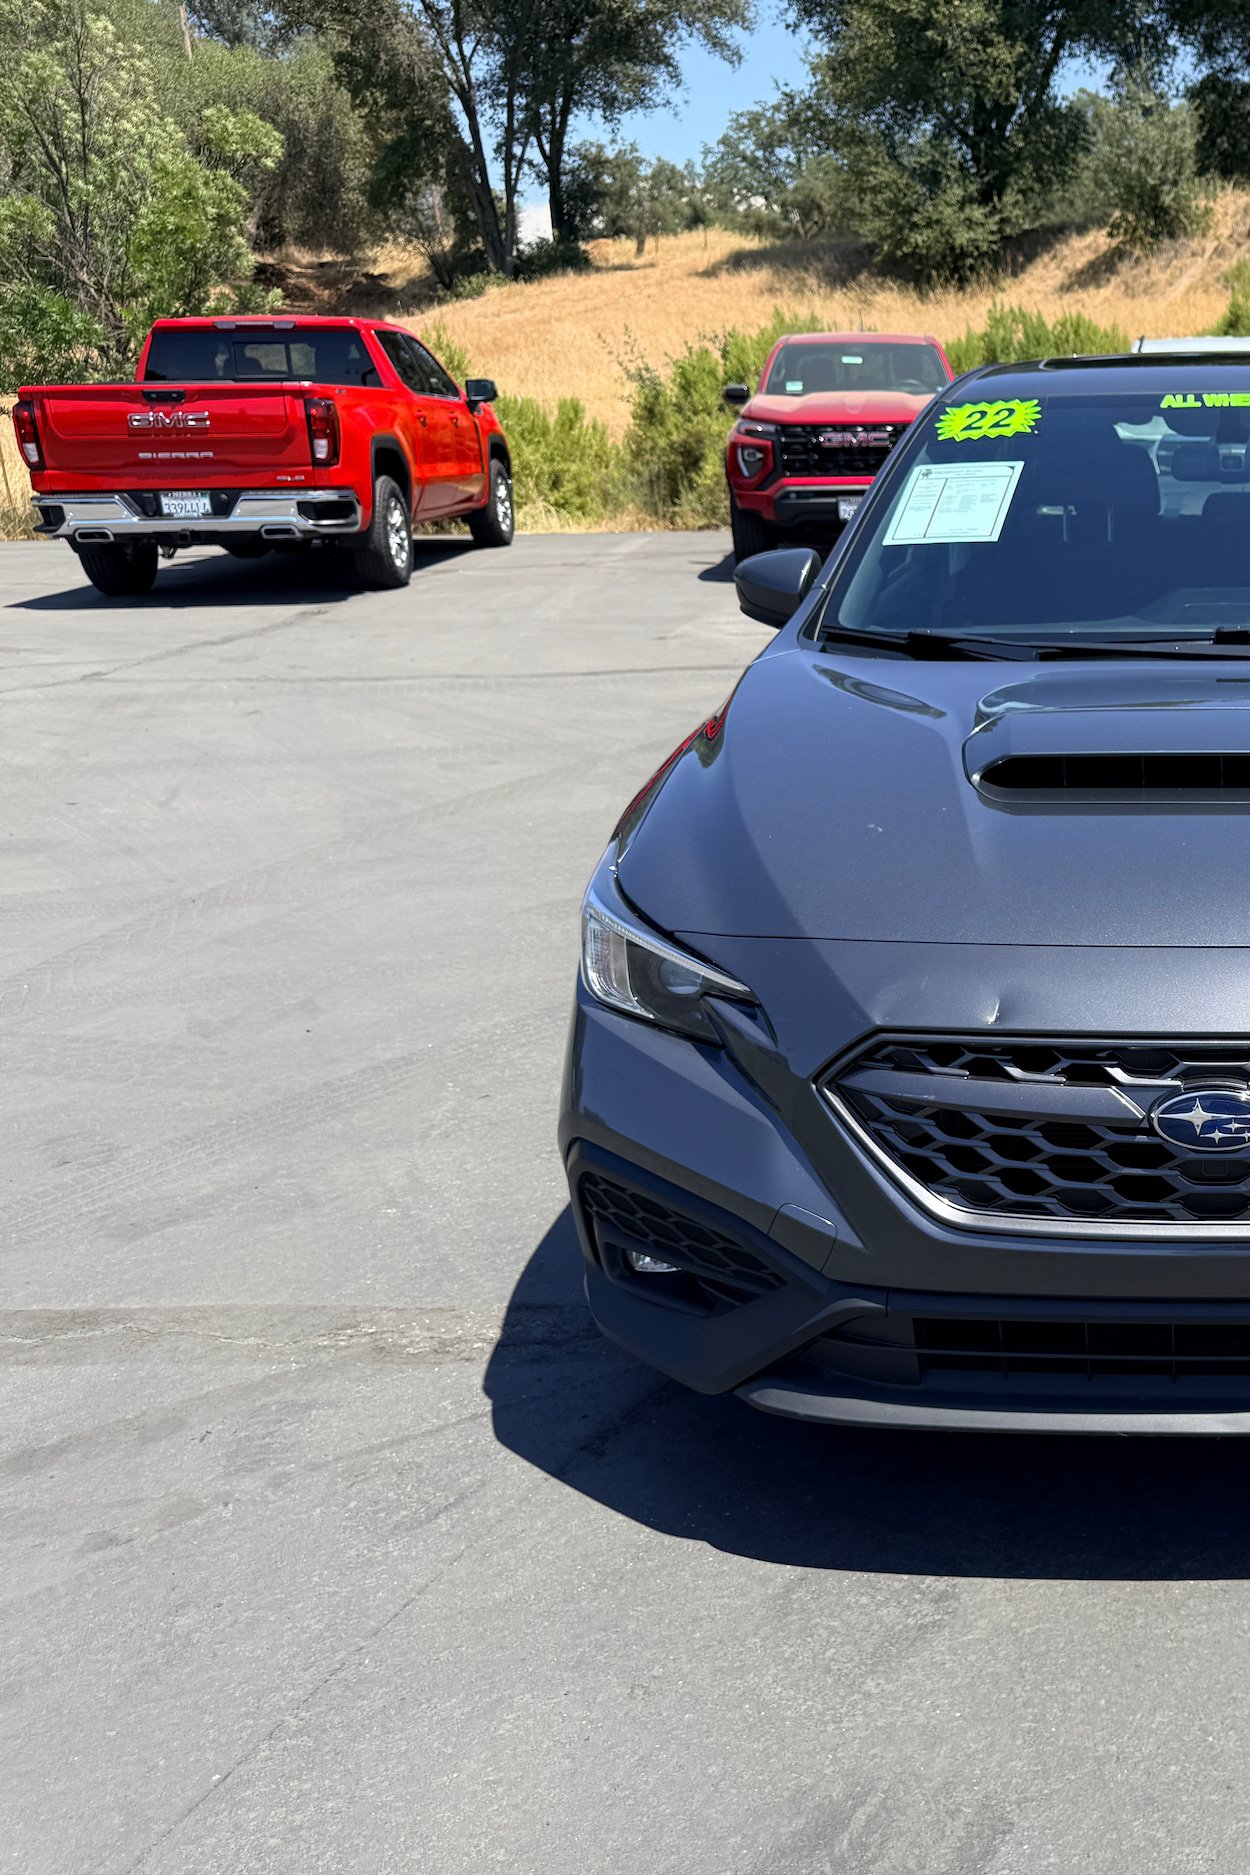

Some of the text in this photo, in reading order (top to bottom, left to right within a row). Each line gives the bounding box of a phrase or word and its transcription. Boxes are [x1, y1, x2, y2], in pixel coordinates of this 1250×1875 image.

[1160, 394, 1202, 408] ALL
[127, 411, 211, 428] GMC
[960, 408, 1016, 432] 22
[821, 432, 890, 448] GMC
[138, 451, 214, 459] SIERRA
